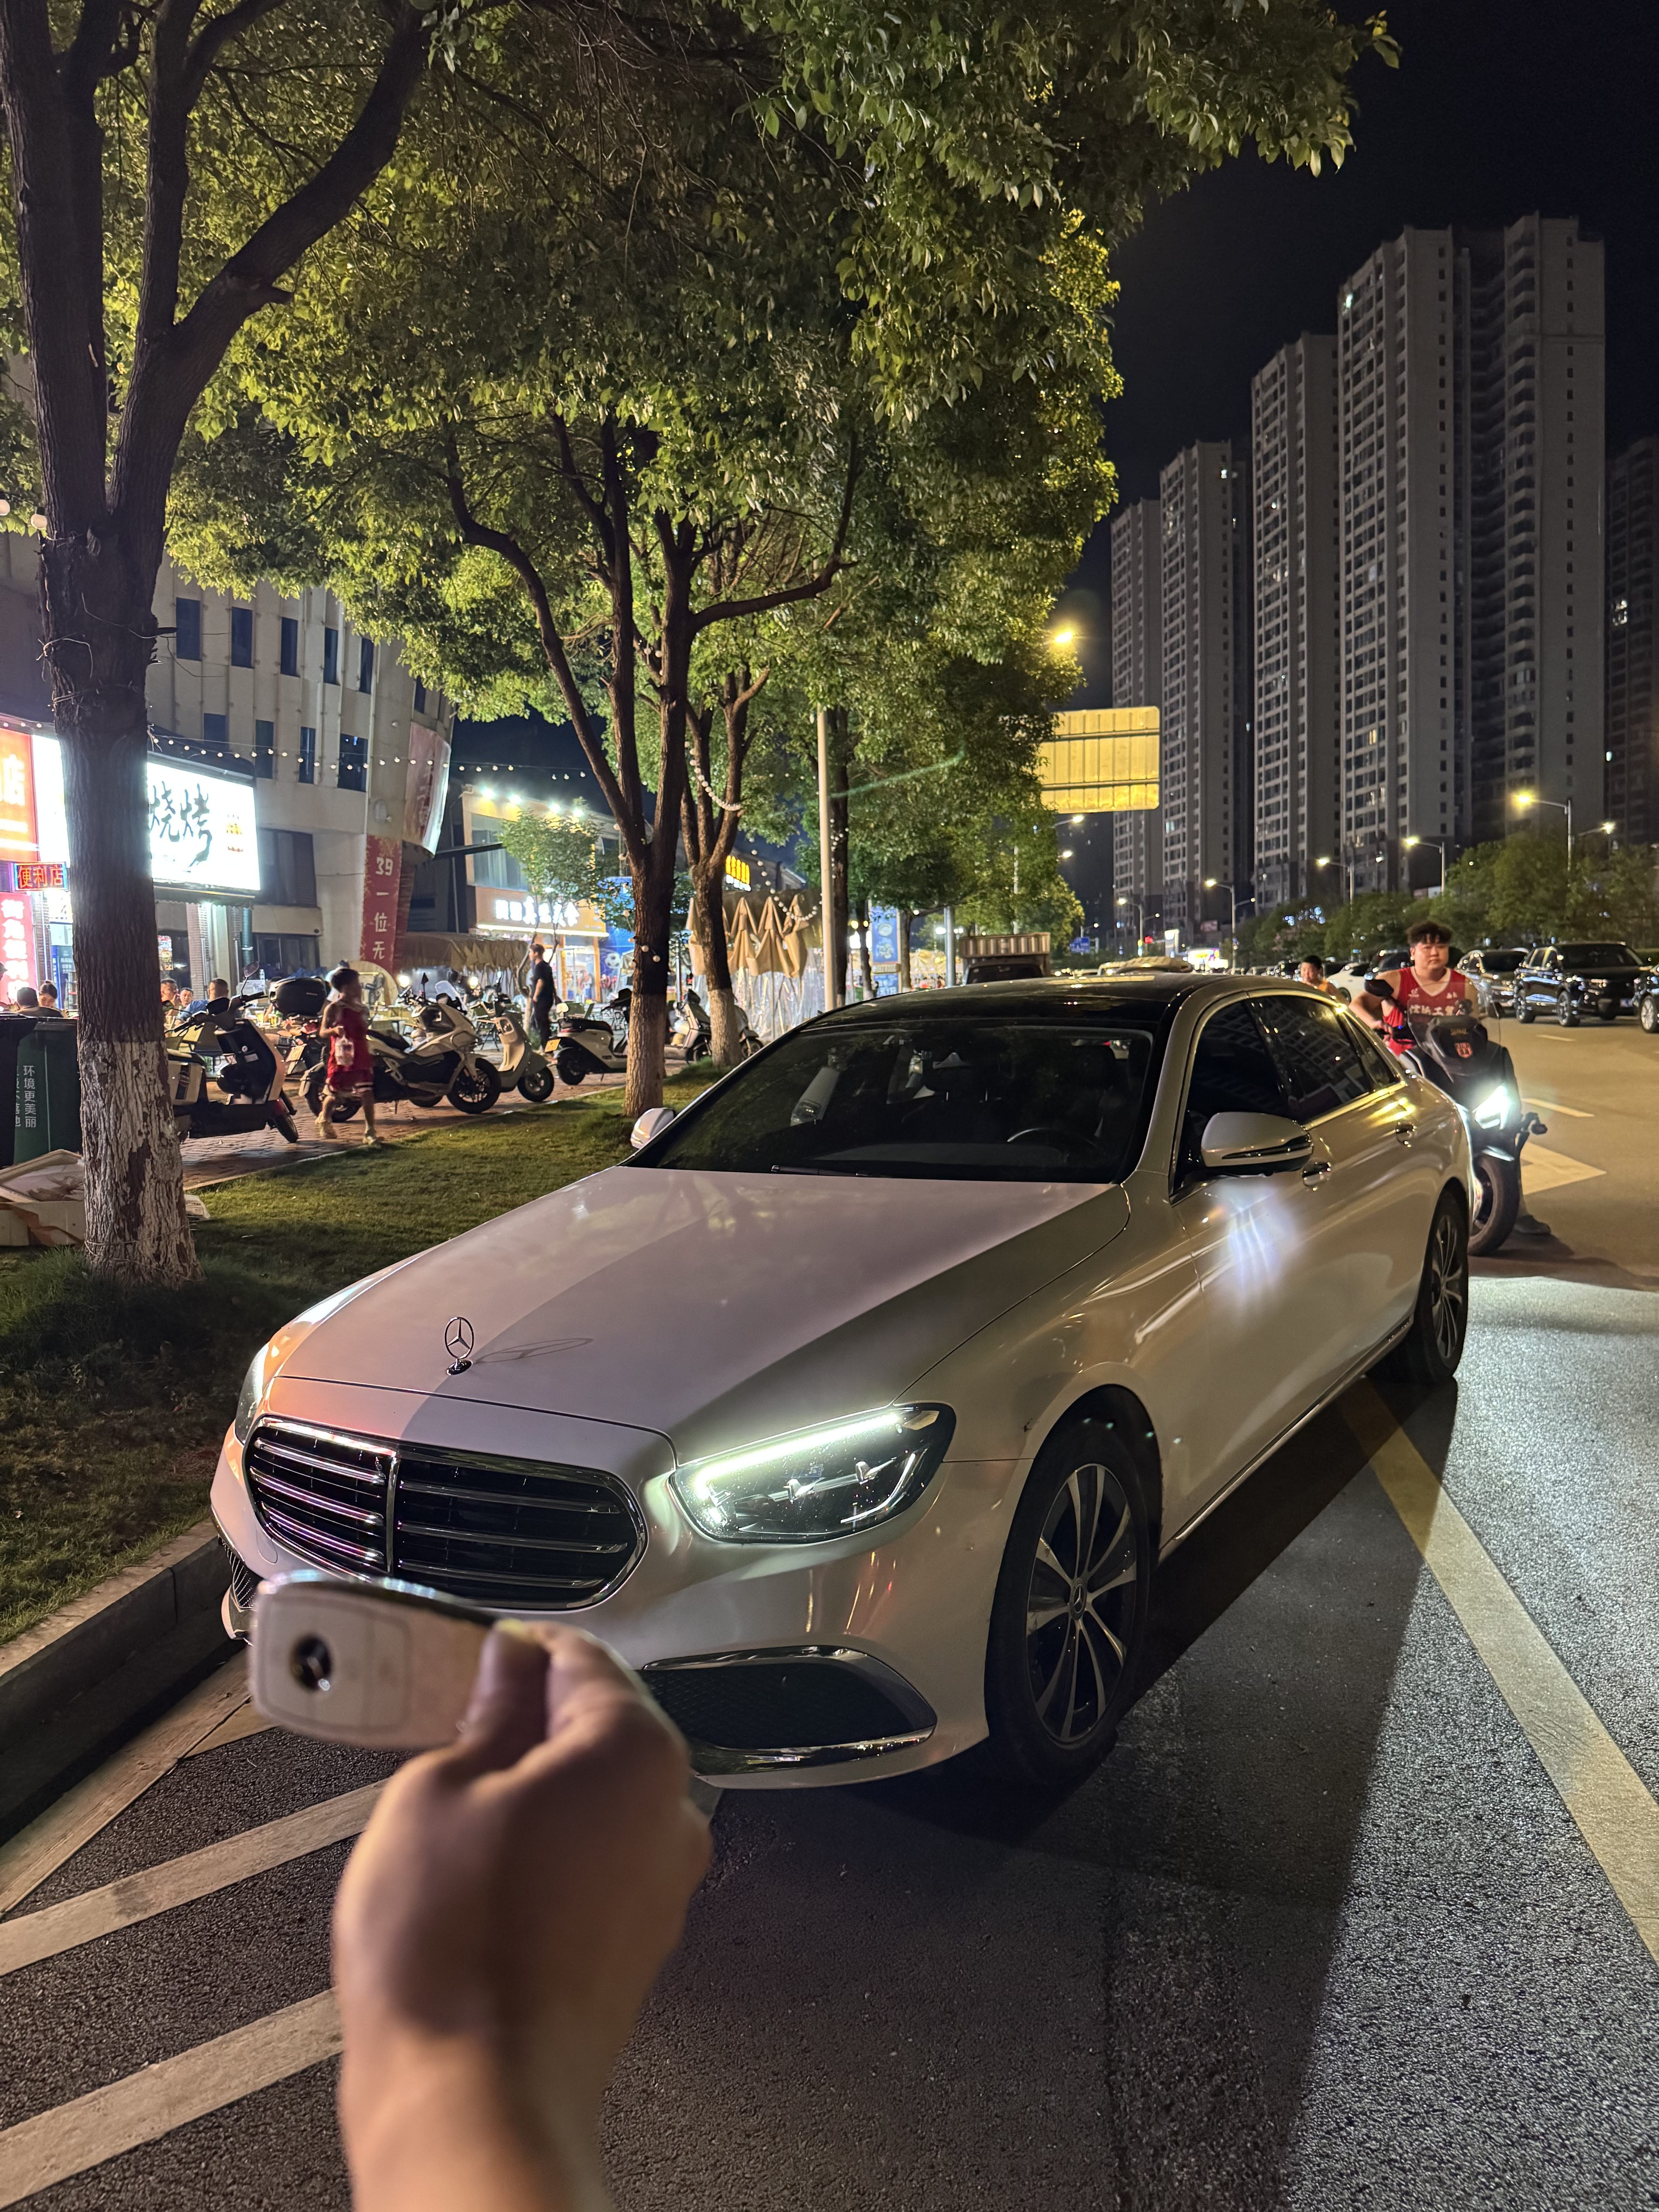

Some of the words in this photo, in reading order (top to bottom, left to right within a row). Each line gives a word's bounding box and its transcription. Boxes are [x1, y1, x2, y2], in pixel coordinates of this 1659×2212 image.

[149, 781, 212, 867] 烧烤
[18, 865, 63, 888] 便利店
[23, 1065, 37, 1128] 环境更美丽
